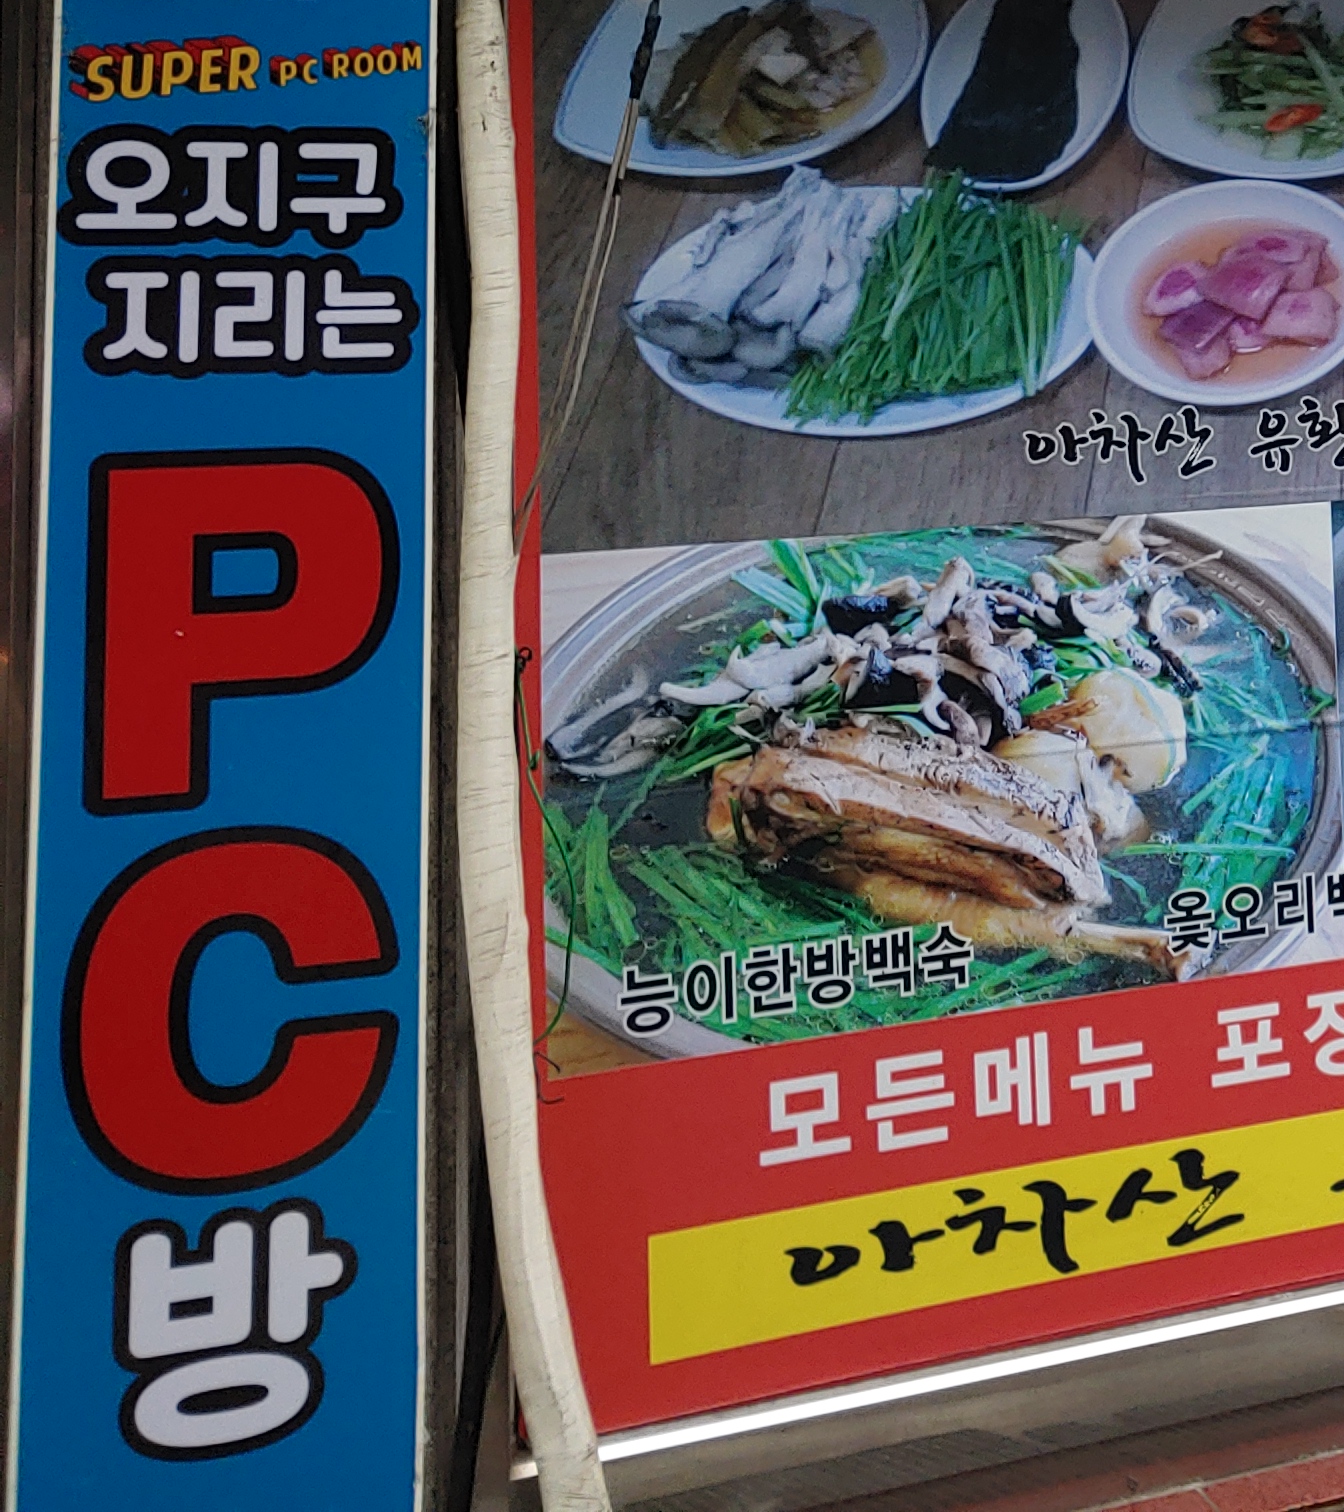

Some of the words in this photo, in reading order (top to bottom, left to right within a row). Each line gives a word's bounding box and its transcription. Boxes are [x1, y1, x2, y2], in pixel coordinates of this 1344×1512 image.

[74, 38, 261, 103] SUPER
[272, 54, 319, 87] PC
[324, 42, 423, 80] ROOM
[68, 133, 392, 240] 오지구
[97, 263, 408, 369] 지리는
[1025, 404, 1218, 483] 아차산
[618, 920, 975, 1036] 능이한방백숙
[757, 1023, 1156, 1169] 모든메뉴
[785, 1149, 1246, 1288] 아차산
